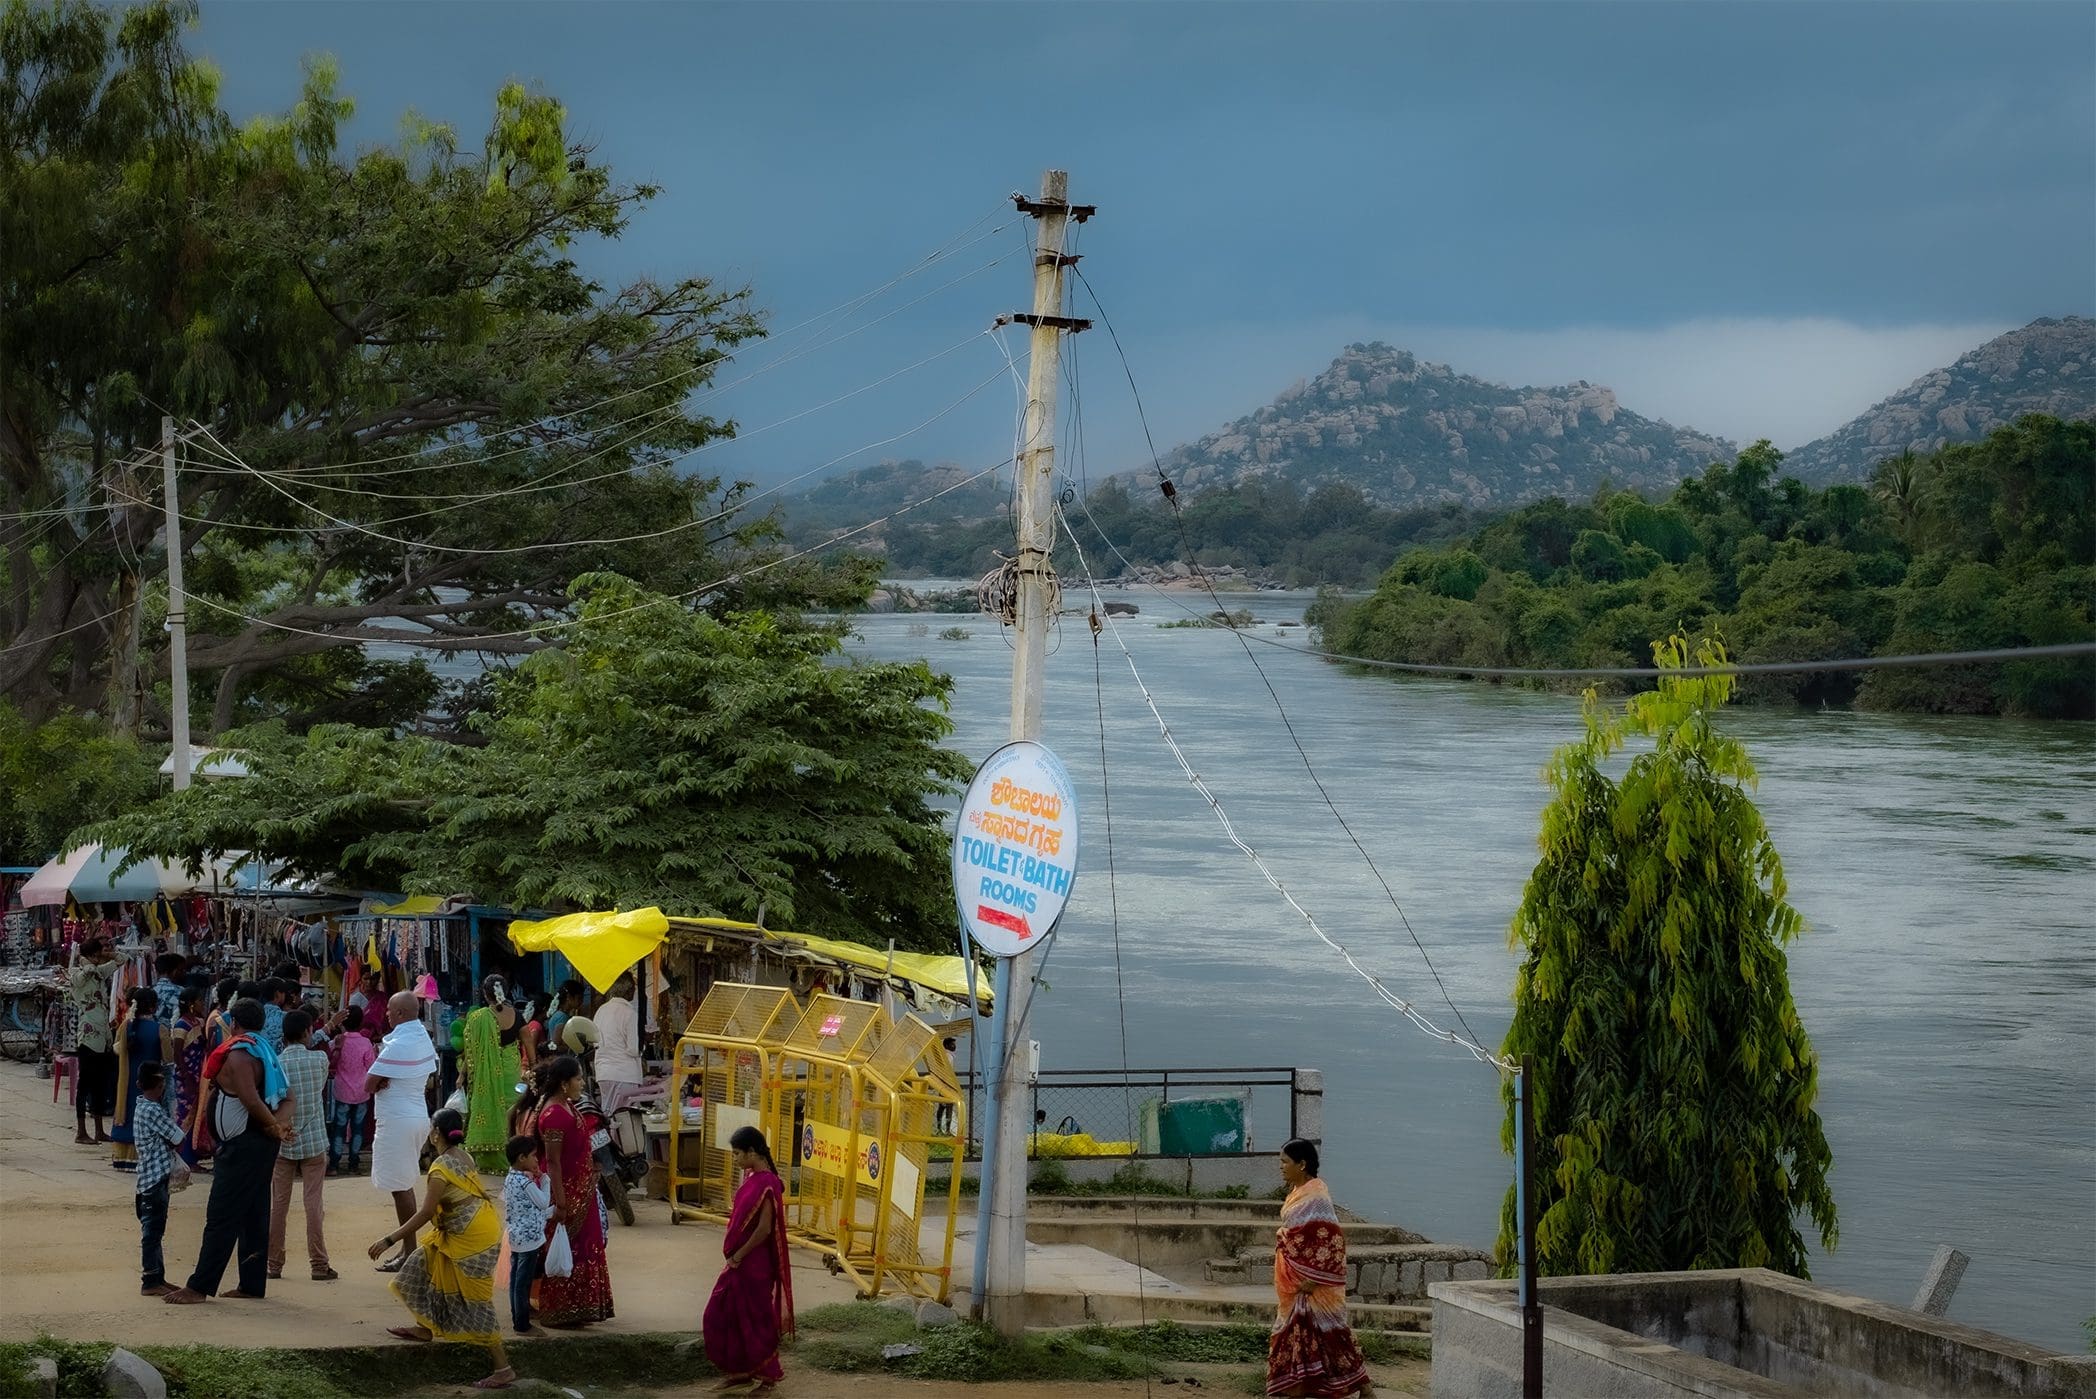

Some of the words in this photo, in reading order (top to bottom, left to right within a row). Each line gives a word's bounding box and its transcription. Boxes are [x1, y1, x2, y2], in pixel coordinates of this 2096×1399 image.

[991, 777, 1061, 821] ಶೌಚಾಲಯ
[962, 836, 1022, 877] TOILET
[1023, 855, 1070, 897] BATH
[980, 876, 1038, 914] ROOMS
